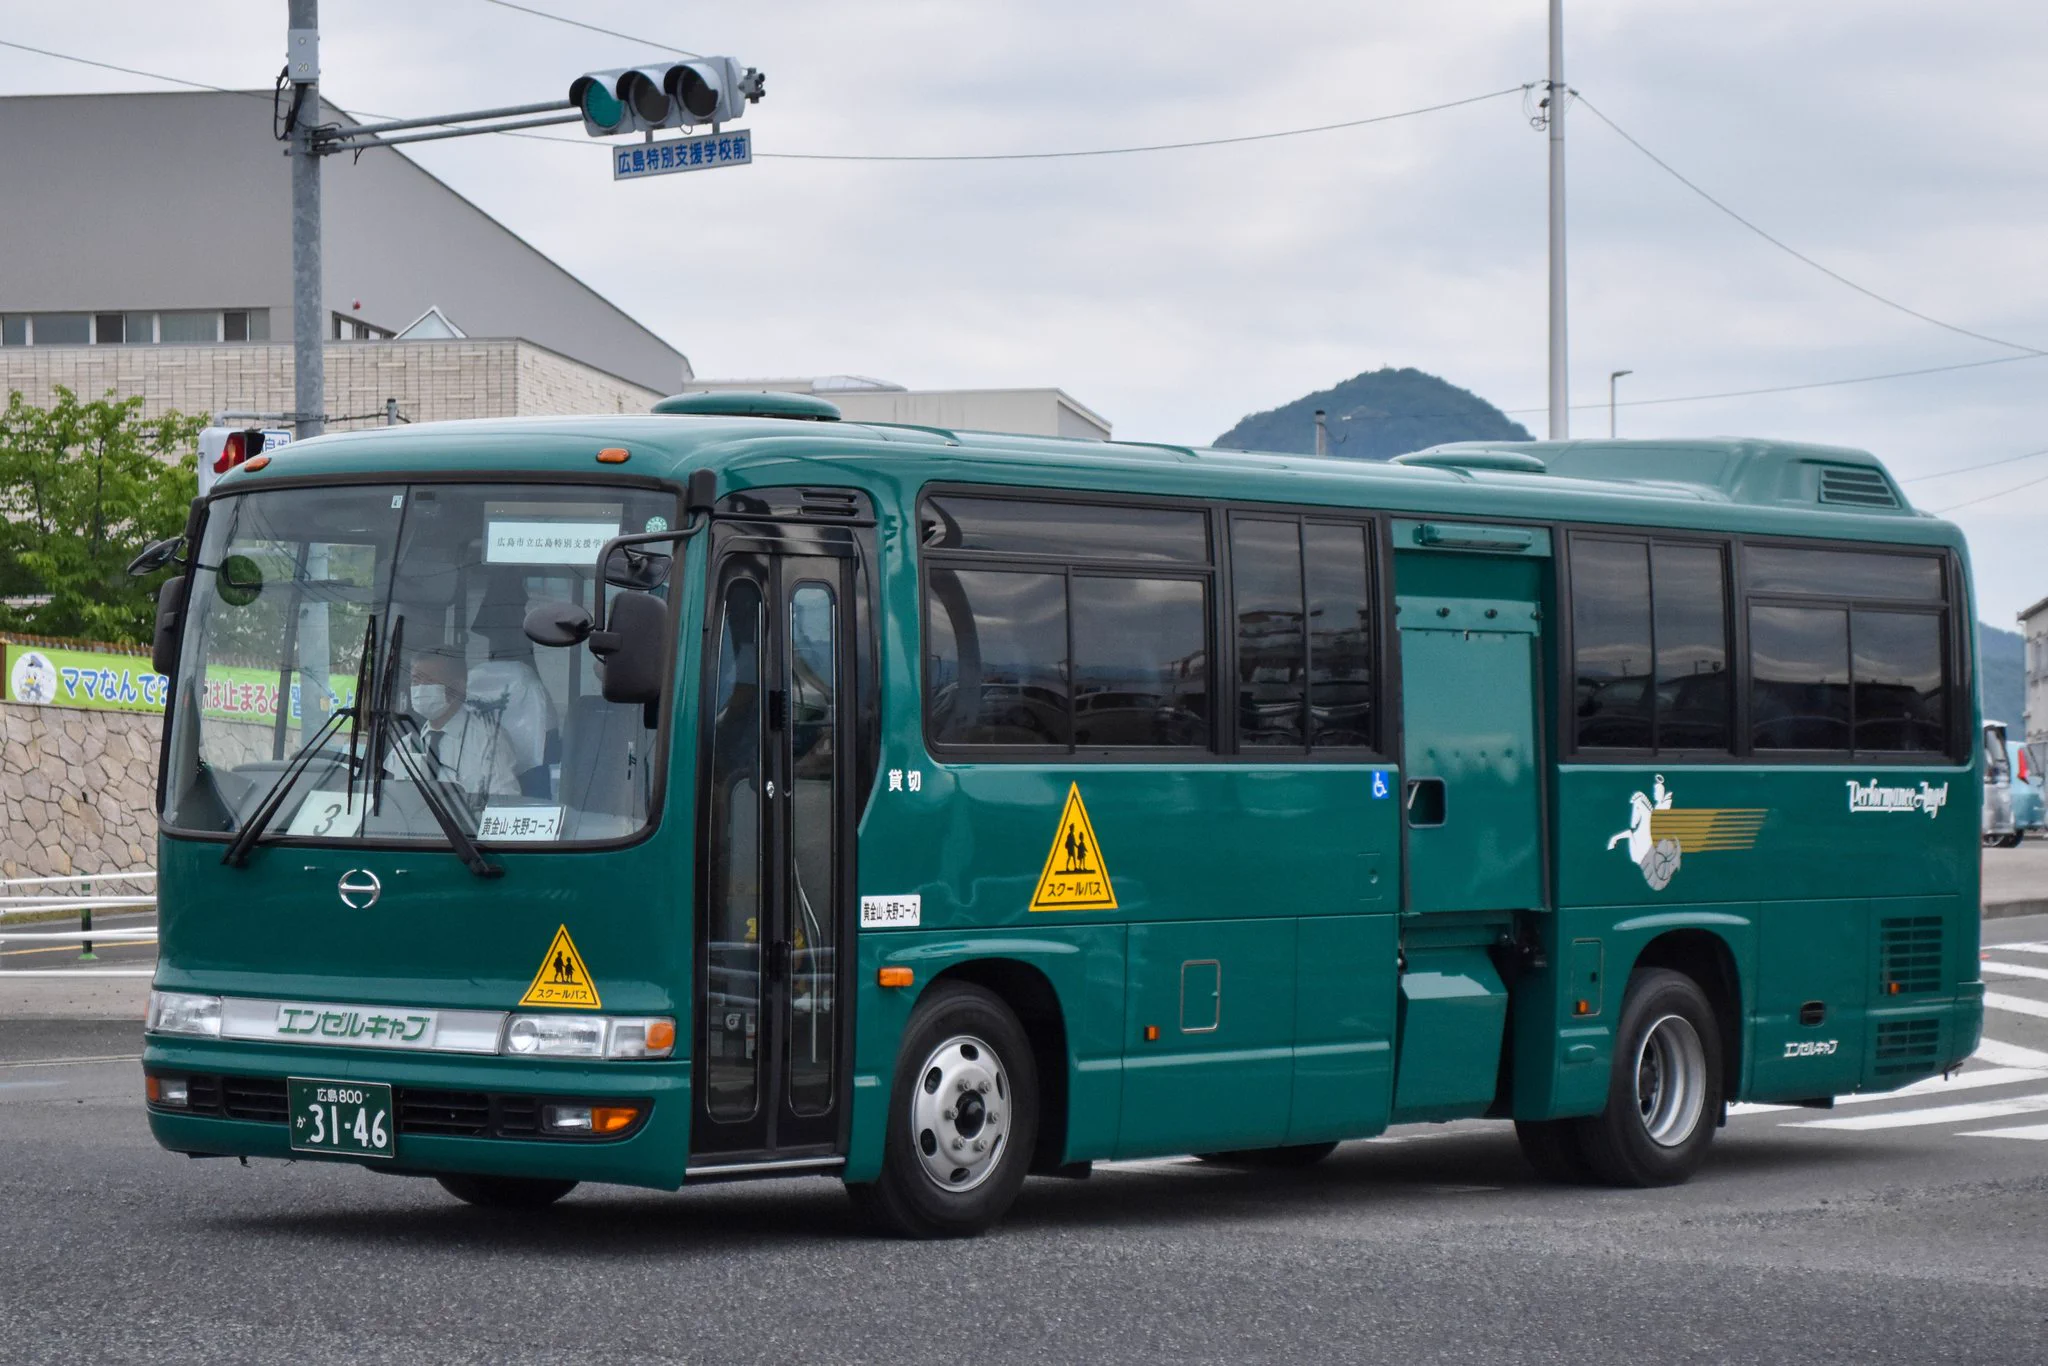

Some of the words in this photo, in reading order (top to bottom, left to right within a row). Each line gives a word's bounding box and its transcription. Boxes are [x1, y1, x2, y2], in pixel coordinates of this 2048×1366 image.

[618, 137, 746, 174] 広島特別支援学校前
[497, 537, 609, 549] 広島市立広島特別支援学
[888, 769, 922, 792] 貸切
[1047, 881, 1102, 897] スクールバス
[536, 987, 588, 1001] スクールバス
[278, 1008, 430, 1041] エンゼルキャブ
[296, 1115, 307, 1130] か
[308, 1103, 388, 1149] 31-46
